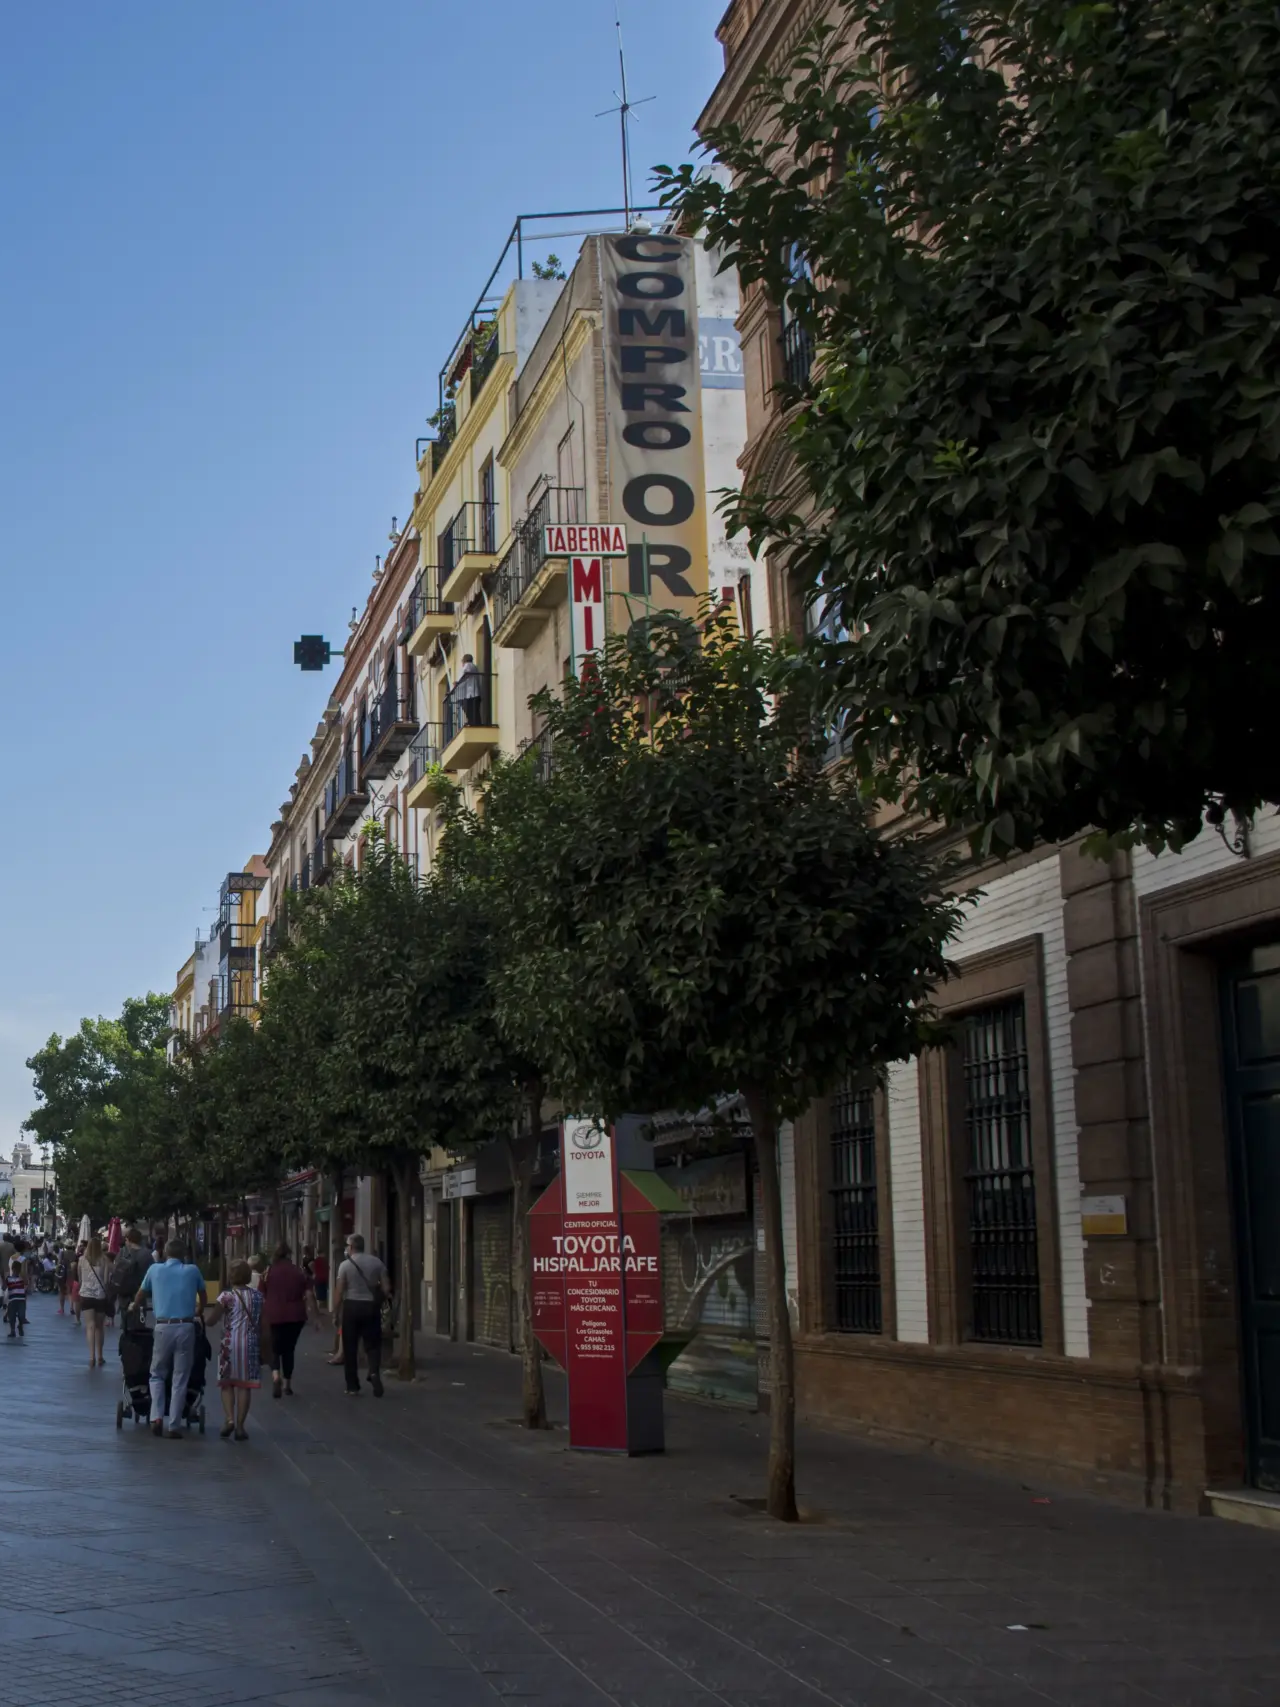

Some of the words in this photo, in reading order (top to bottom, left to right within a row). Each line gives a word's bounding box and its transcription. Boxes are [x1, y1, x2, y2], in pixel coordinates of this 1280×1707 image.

[614, 235, 692, 450] COMPRO
[546, 525, 625, 553] TABERNA
[570, 1151, 605, 1160] TOYOTA
[591, 1220, 618, 1228] OFICIAL
[552, 1235, 636, 1255] TOYOTA
[533, 1256, 659, 1273] HISPALJARAFE
